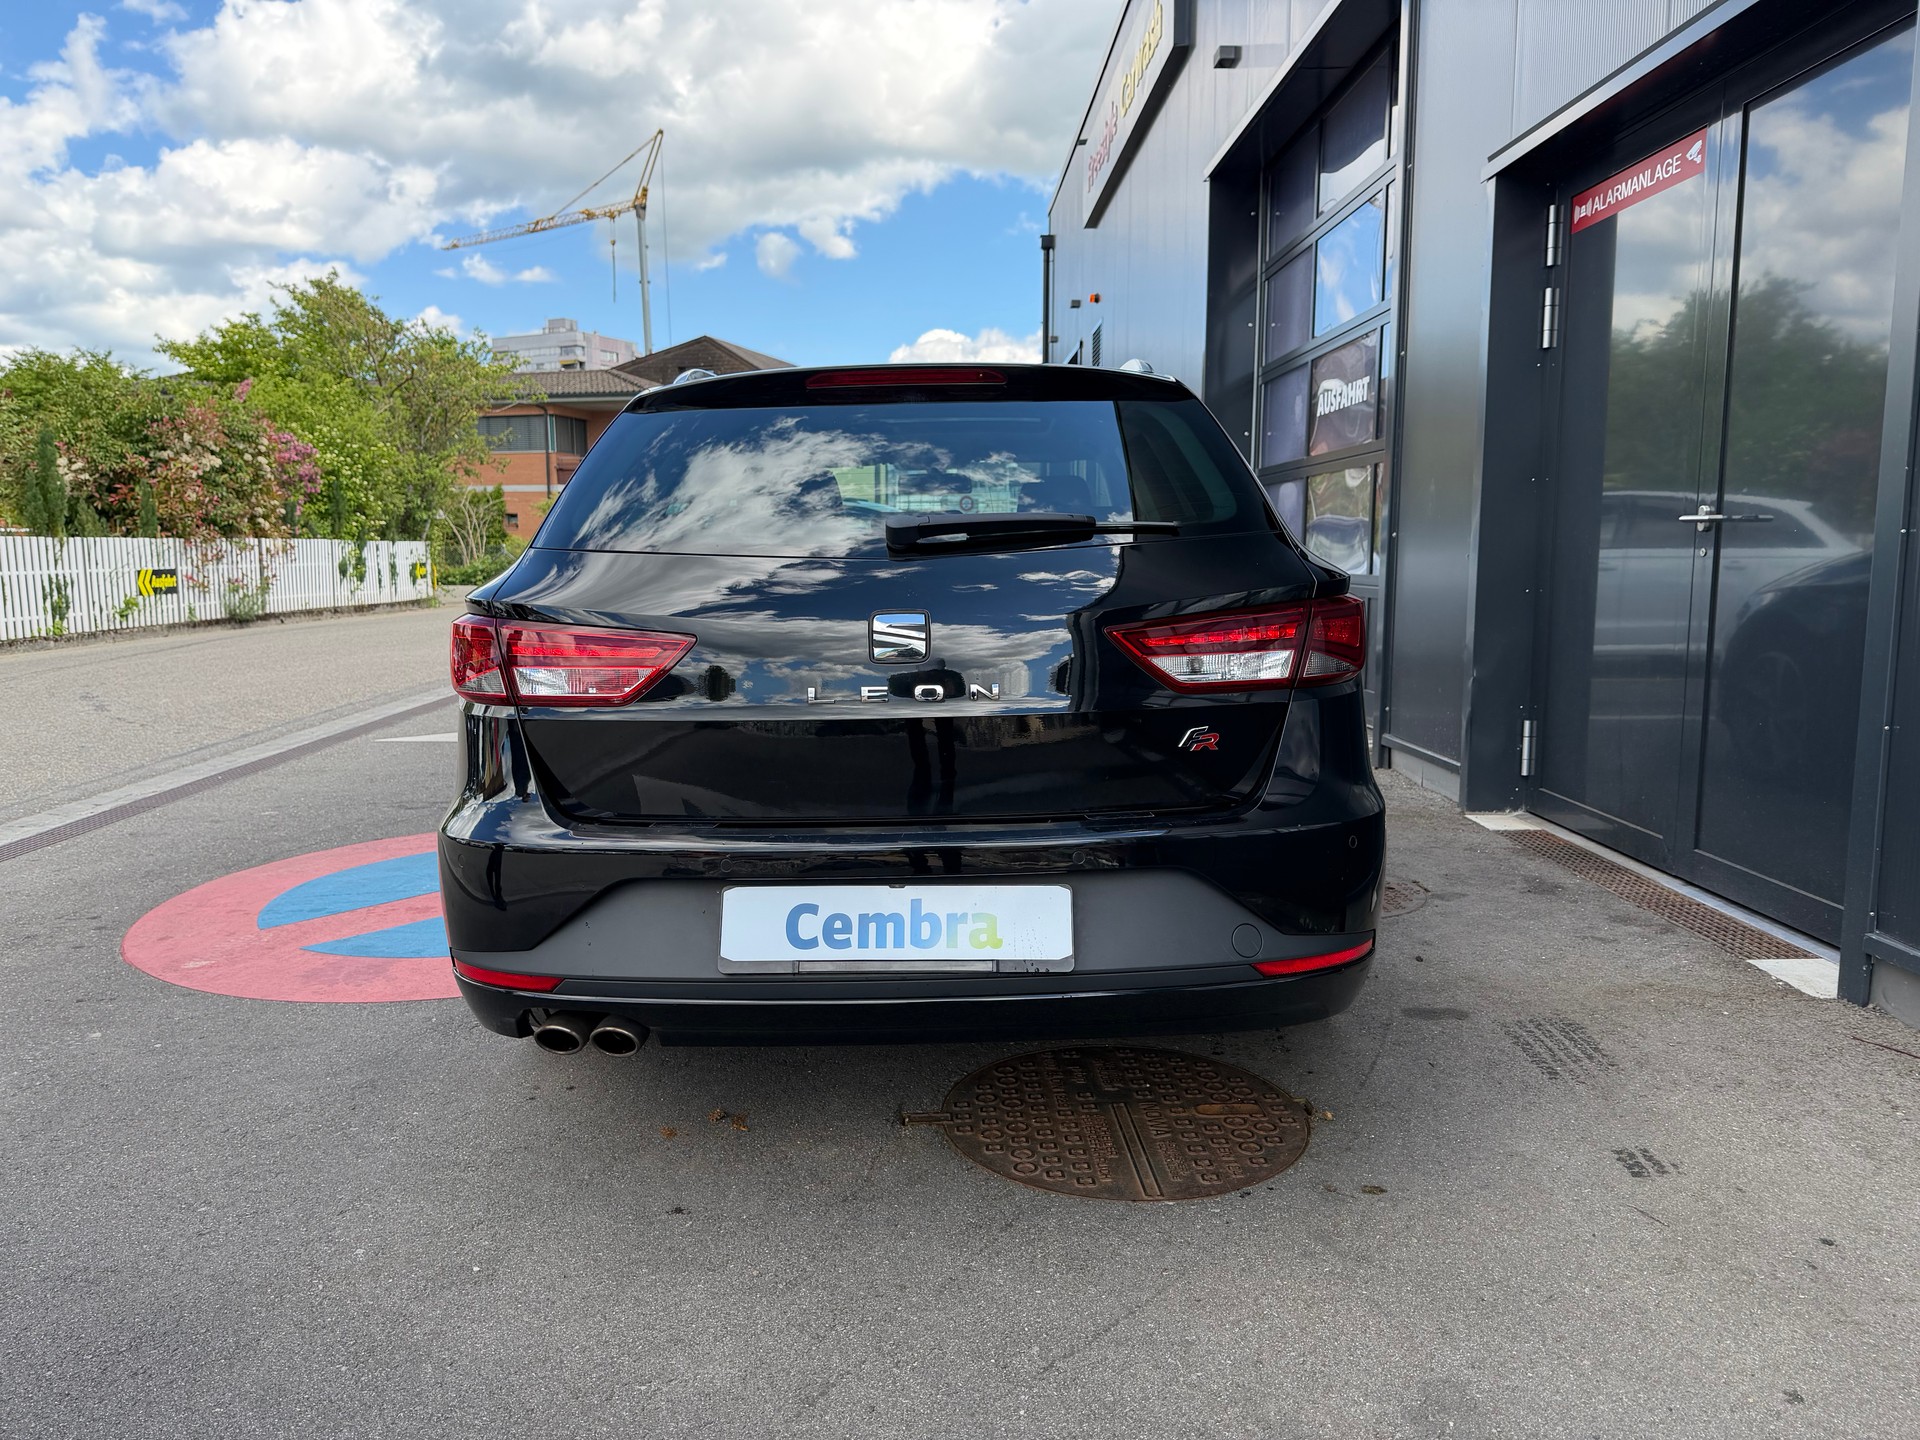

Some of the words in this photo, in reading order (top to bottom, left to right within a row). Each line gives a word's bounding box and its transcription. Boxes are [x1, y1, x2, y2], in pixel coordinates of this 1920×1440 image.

[1592, 153, 1682, 214] ALARMANLAGE
[1316, 375, 1371, 418] AUSFAHRT
[807, 683, 1000, 705] LEON
[1178, 725, 1221, 752] FR
[785, 898, 1003, 951] Cembra
